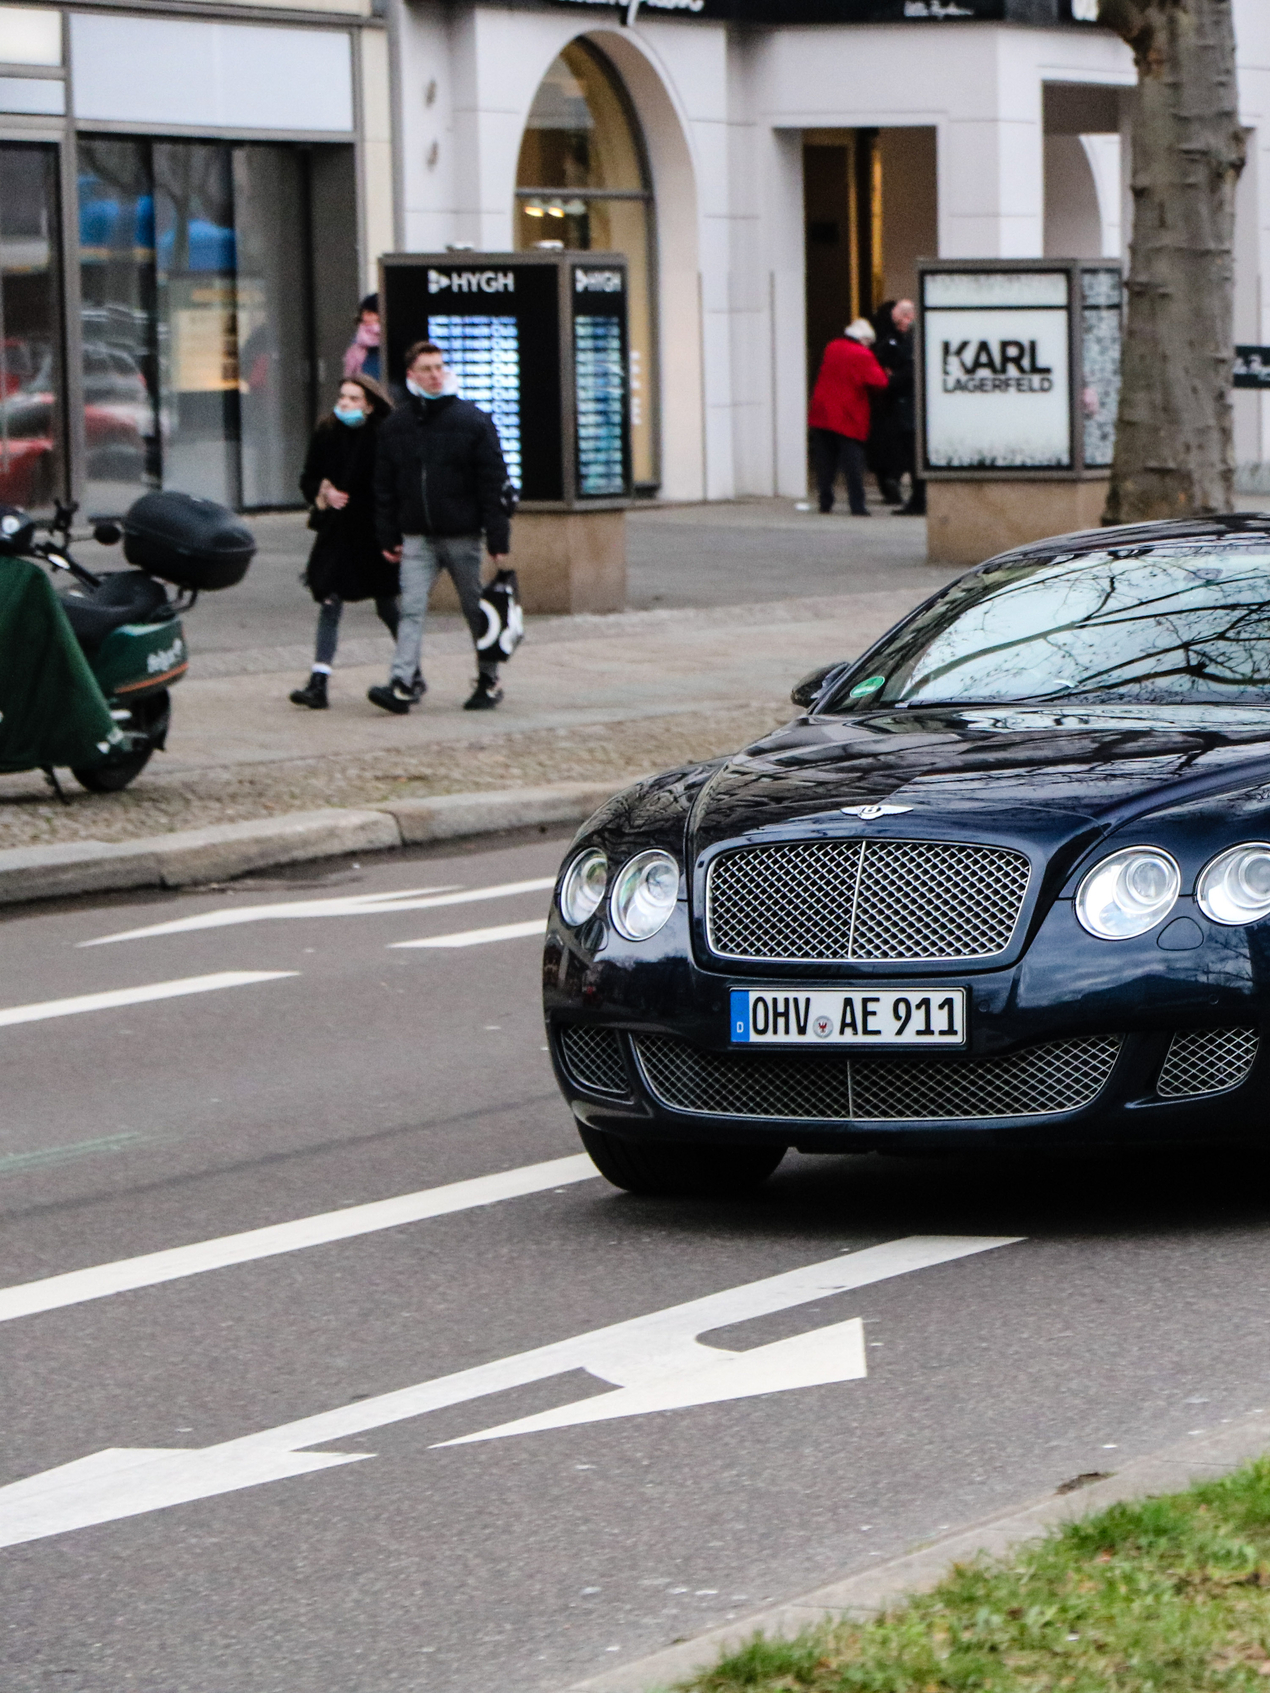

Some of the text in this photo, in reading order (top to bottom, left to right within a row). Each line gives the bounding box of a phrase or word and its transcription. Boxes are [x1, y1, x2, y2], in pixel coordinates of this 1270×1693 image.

[451, 271, 515, 293] HYGH
[942, 340, 1053, 375] KARL
[943, 377, 1053, 393] LAGERFELD
[736, 1021, 744, 1033] D
[752, 996, 959, 1036] OHV AE 911
